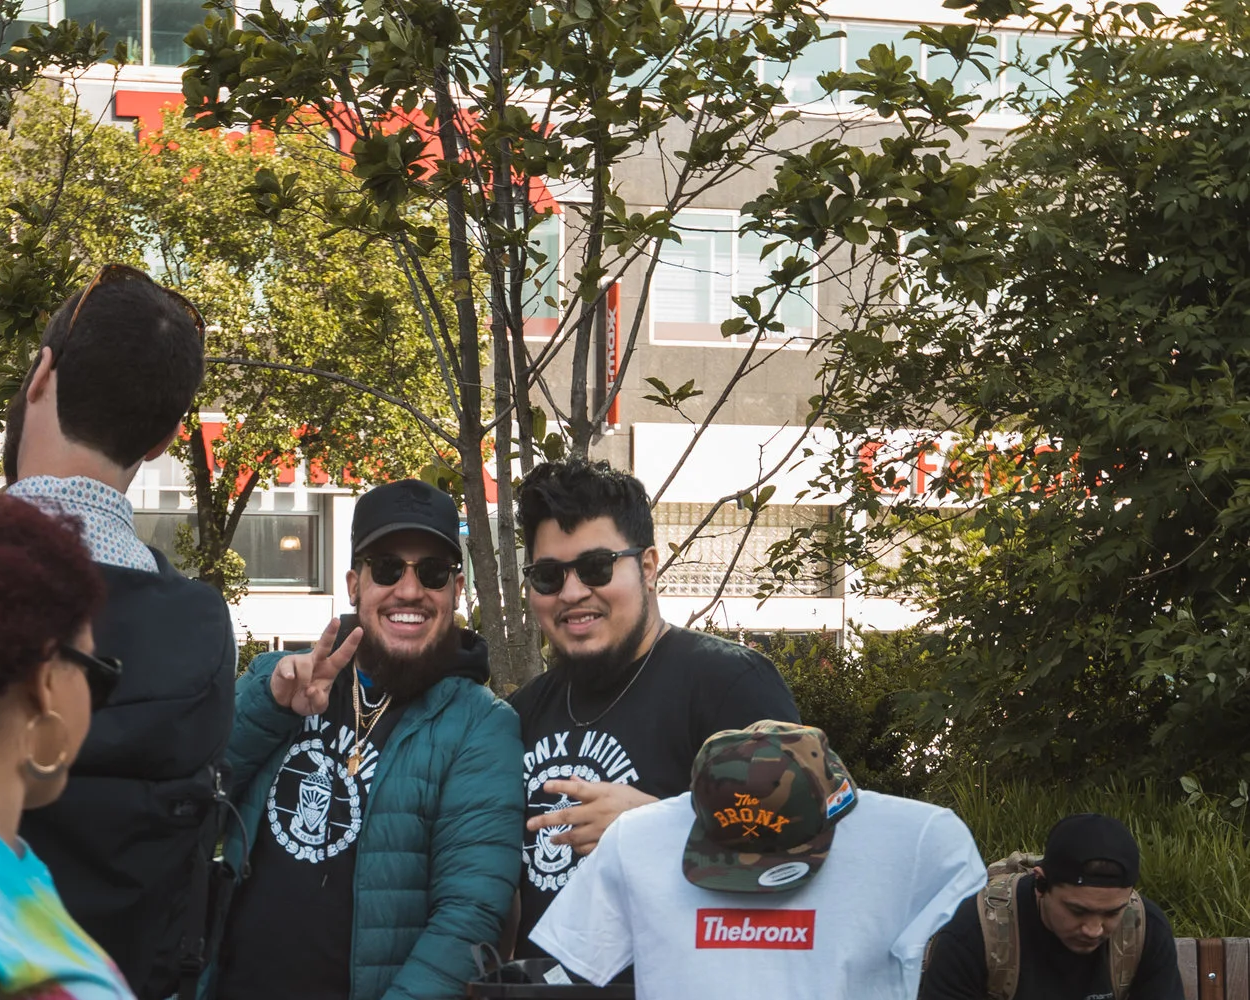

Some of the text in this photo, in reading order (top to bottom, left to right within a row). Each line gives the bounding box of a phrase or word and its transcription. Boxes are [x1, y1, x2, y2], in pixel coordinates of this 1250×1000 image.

[734, 792, 760, 806] The
[714, 808, 790, 833] BRONX
[703, 916, 809, 943] Thebronx
